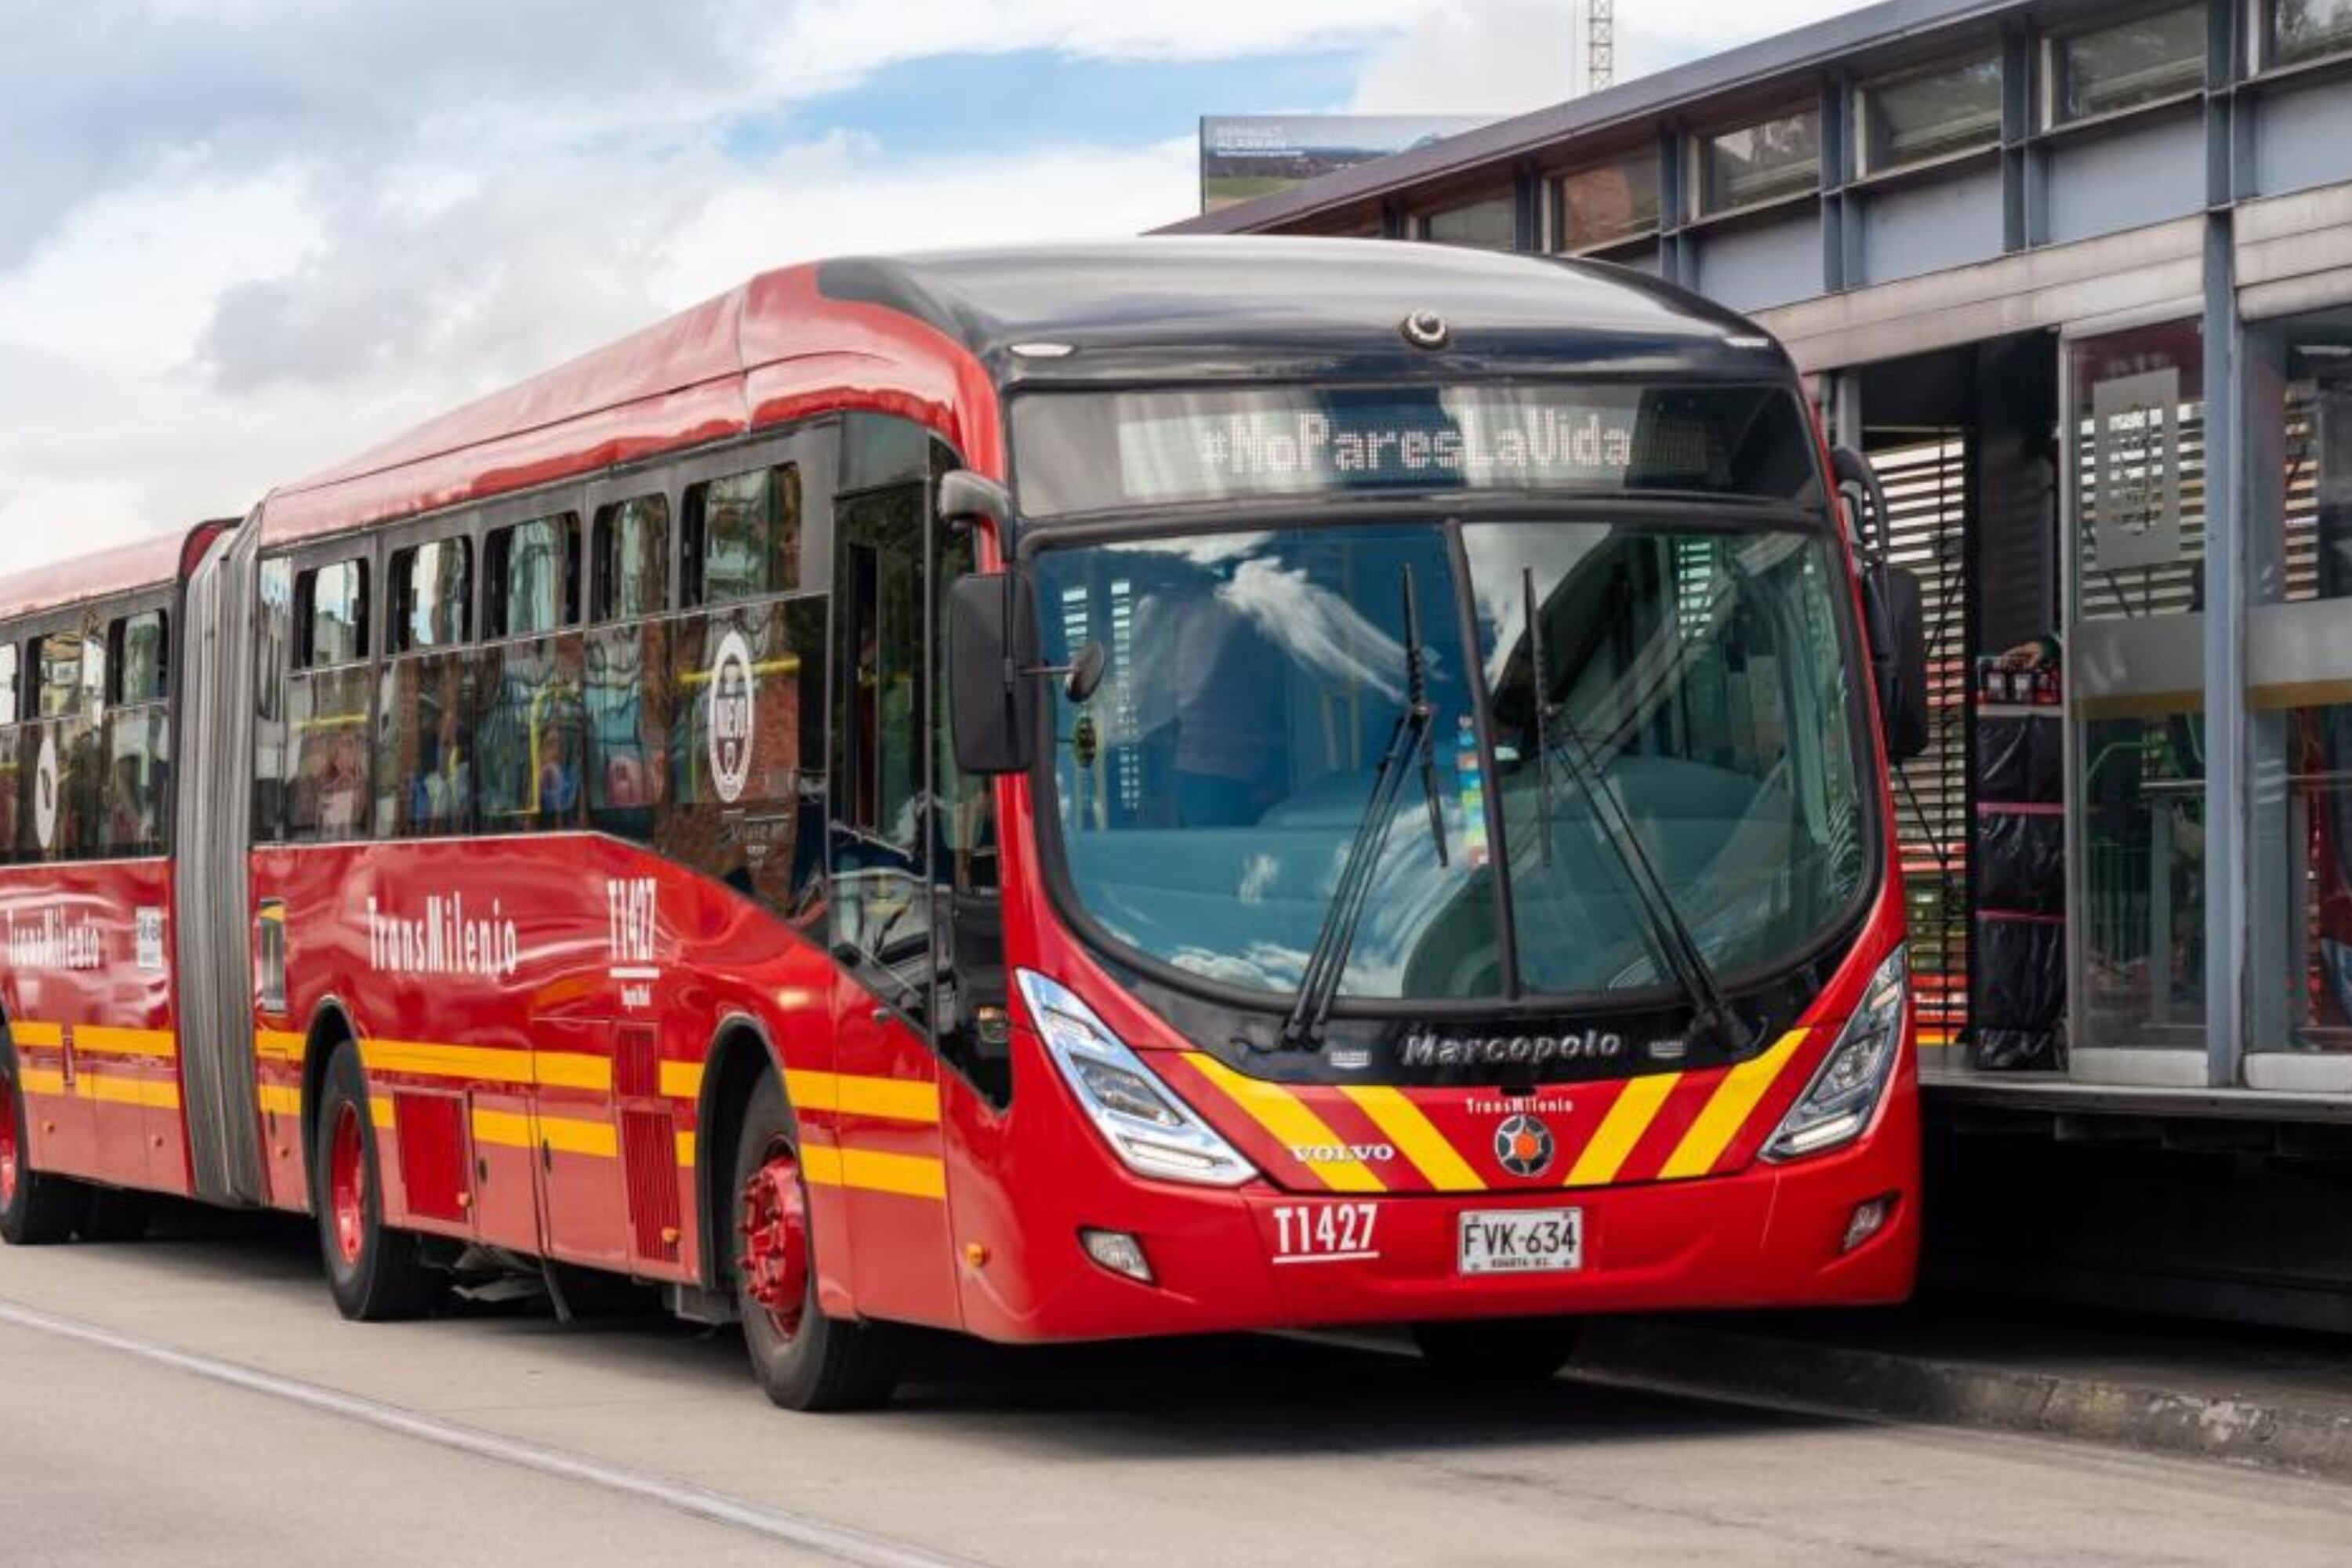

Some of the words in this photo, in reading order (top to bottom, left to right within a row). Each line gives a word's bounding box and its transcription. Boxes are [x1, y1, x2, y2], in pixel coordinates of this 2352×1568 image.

[1202, 406, 1632, 474] #NoParesLaVida
[366, 891, 517, 982] TransMilenio
[608, 878, 656, 960] T1427
[1402, 1029, 1622, 1066] Marcopolo
[1465, 1096, 1574, 1114] TransMilenio
[1291, 1144, 1396, 1163] VOLVO
[1272, 1203, 1378, 1254] T1427
[1464, 1221, 1577, 1256] FVK-634
